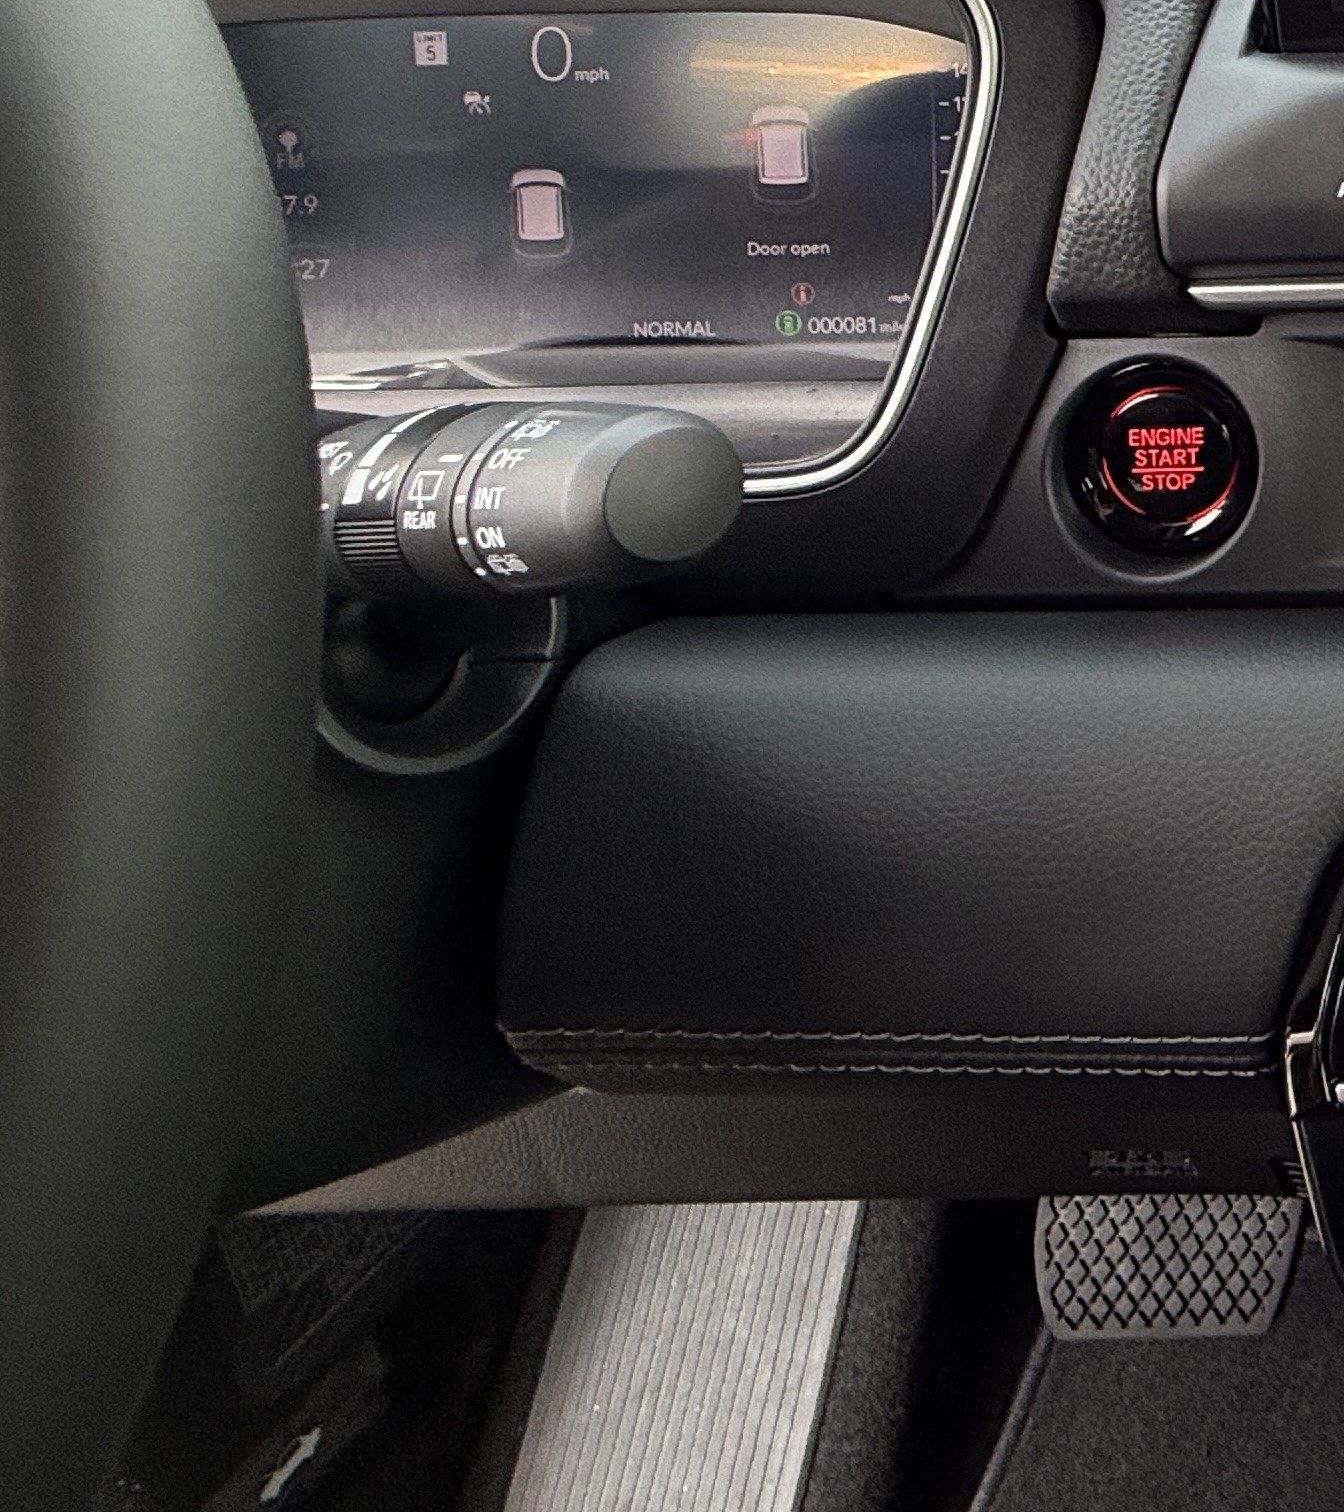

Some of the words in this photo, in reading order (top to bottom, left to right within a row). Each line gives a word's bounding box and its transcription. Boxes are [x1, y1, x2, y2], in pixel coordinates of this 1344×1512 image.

[426, 45, 436, 61] 5
[531, 26, 572, 82] 0
[575, 67, 610, 83] mph
[747, 241, 787, 256] Door
[790, 242, 831, 258] open
[633, 320, 716, 338] NORMAL
[807, 316, 877, 334] 000081
[1128, 426, 1205, 447] ENGINE
[488, 447, 532, 471] OFF
[1134, 447, 1200, 468] START
[1141, 472, 1196, 491] STOP
[475, 485, 506, 510] INT
[403, 510, 436, 530] REAR
[475, 526, 506, 549] ON
